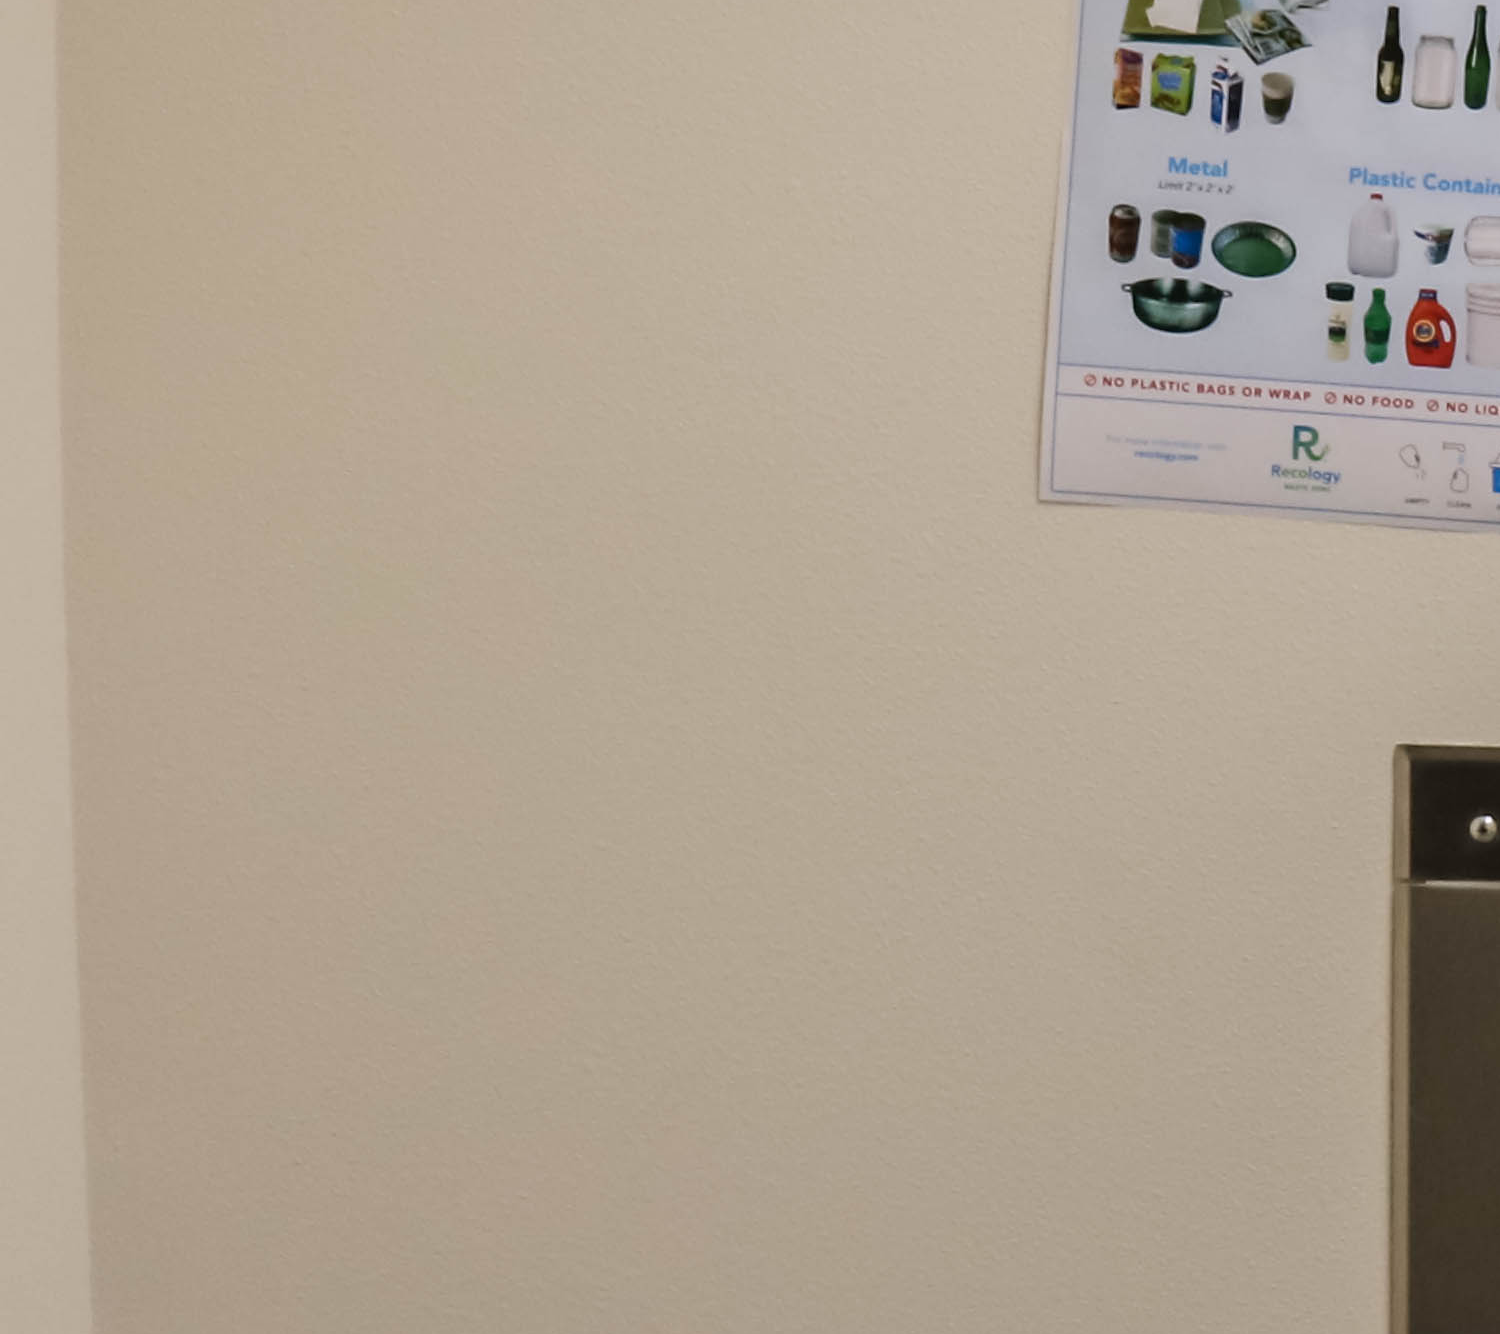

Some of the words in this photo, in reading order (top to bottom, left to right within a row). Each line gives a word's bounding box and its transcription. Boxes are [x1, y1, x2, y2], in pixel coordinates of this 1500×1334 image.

[1167, 155, 1228, 178] Metal
[1347, 166, 1416, 189] Plastic
[1101, 375, 1125, 388] NO
[1130, 377, 1190, 393] PLASTIC
[1195, 382, 1235, 396] BAGS
[1240, 385, 1263, 398] OR
[1267, 387, 1311, 401] WRAP
[1342, 393, 1366, 406] NO
[1370, 394, 1415, 410] FOOD
[1445, 401, 1469, 414] NO
[1270, 463, 1341, 485] Recology
